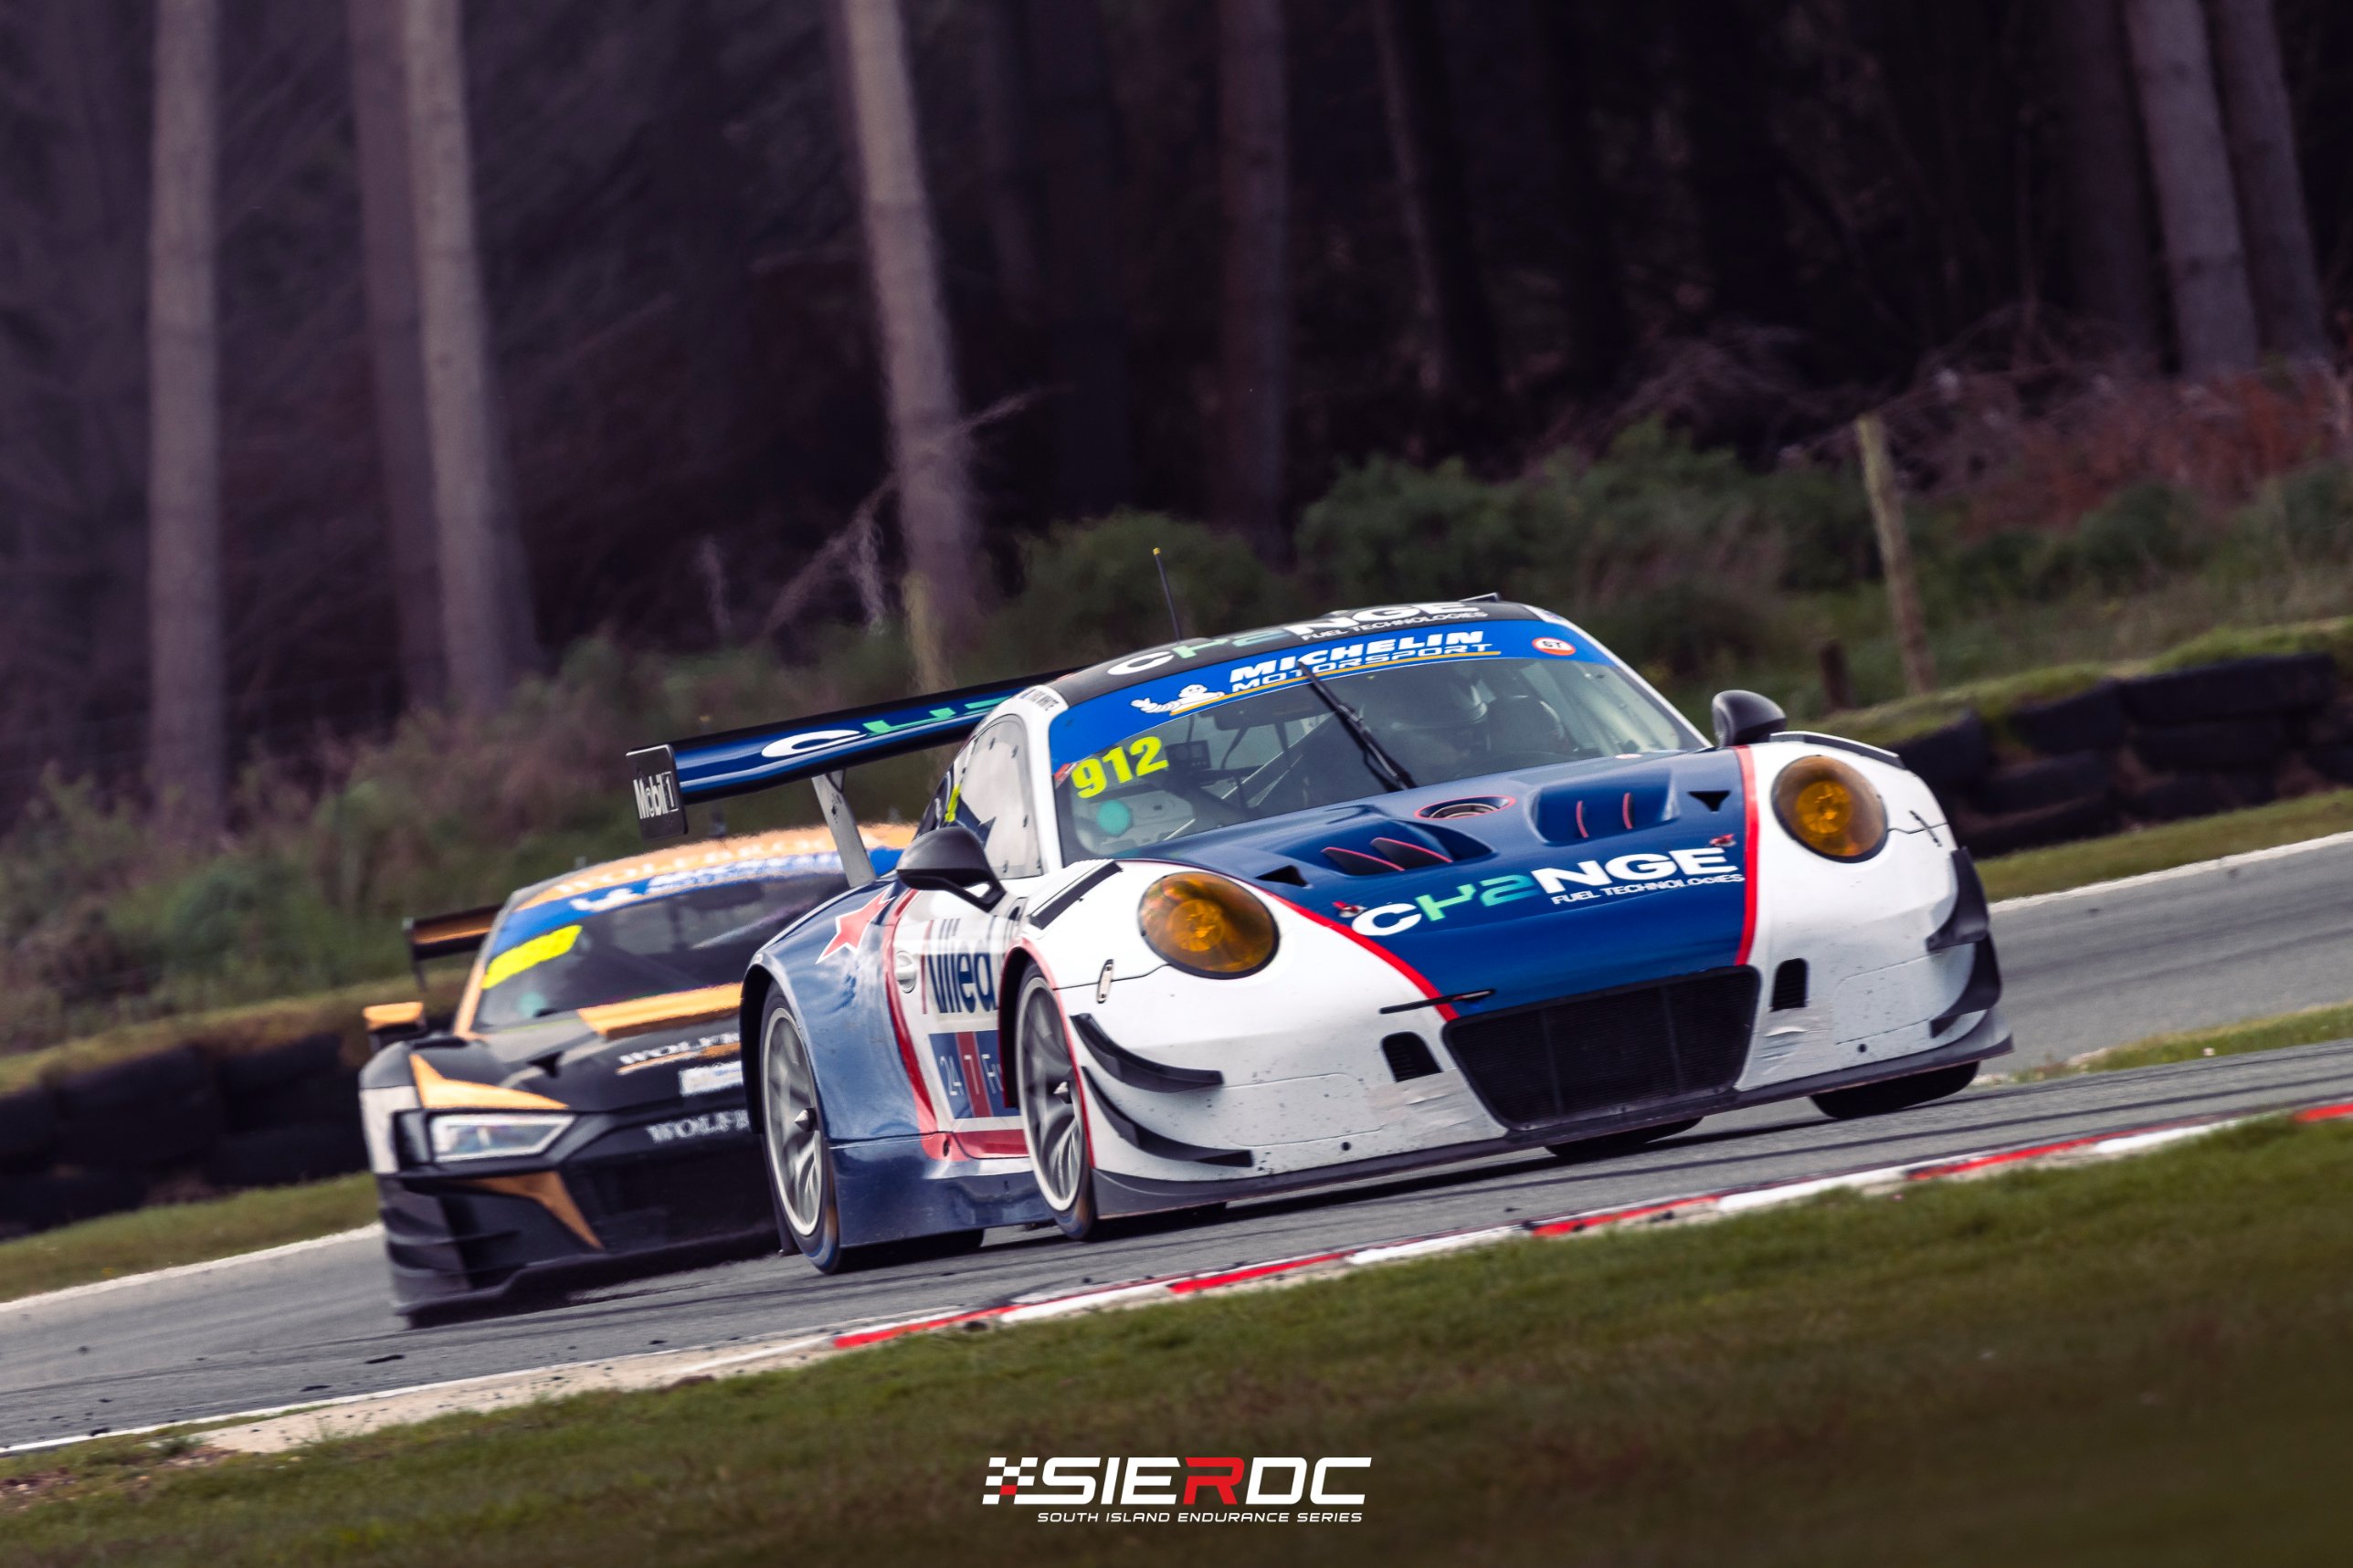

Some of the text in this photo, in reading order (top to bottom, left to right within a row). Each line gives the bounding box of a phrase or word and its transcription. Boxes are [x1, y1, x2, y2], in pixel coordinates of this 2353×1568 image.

[1301, 611, 1489, 641] FUEL TECHNOLOGIES
[1229, 630, 1484, 683] MICHELIN
[1231, 643, 1493, 692] MOTORSPORT
[1071, 735, 1169, 799] 912
[633, 773, 668, 820] Mobil
[1552, 873, 1746, 905] FUEL TECHNOLOGIES
